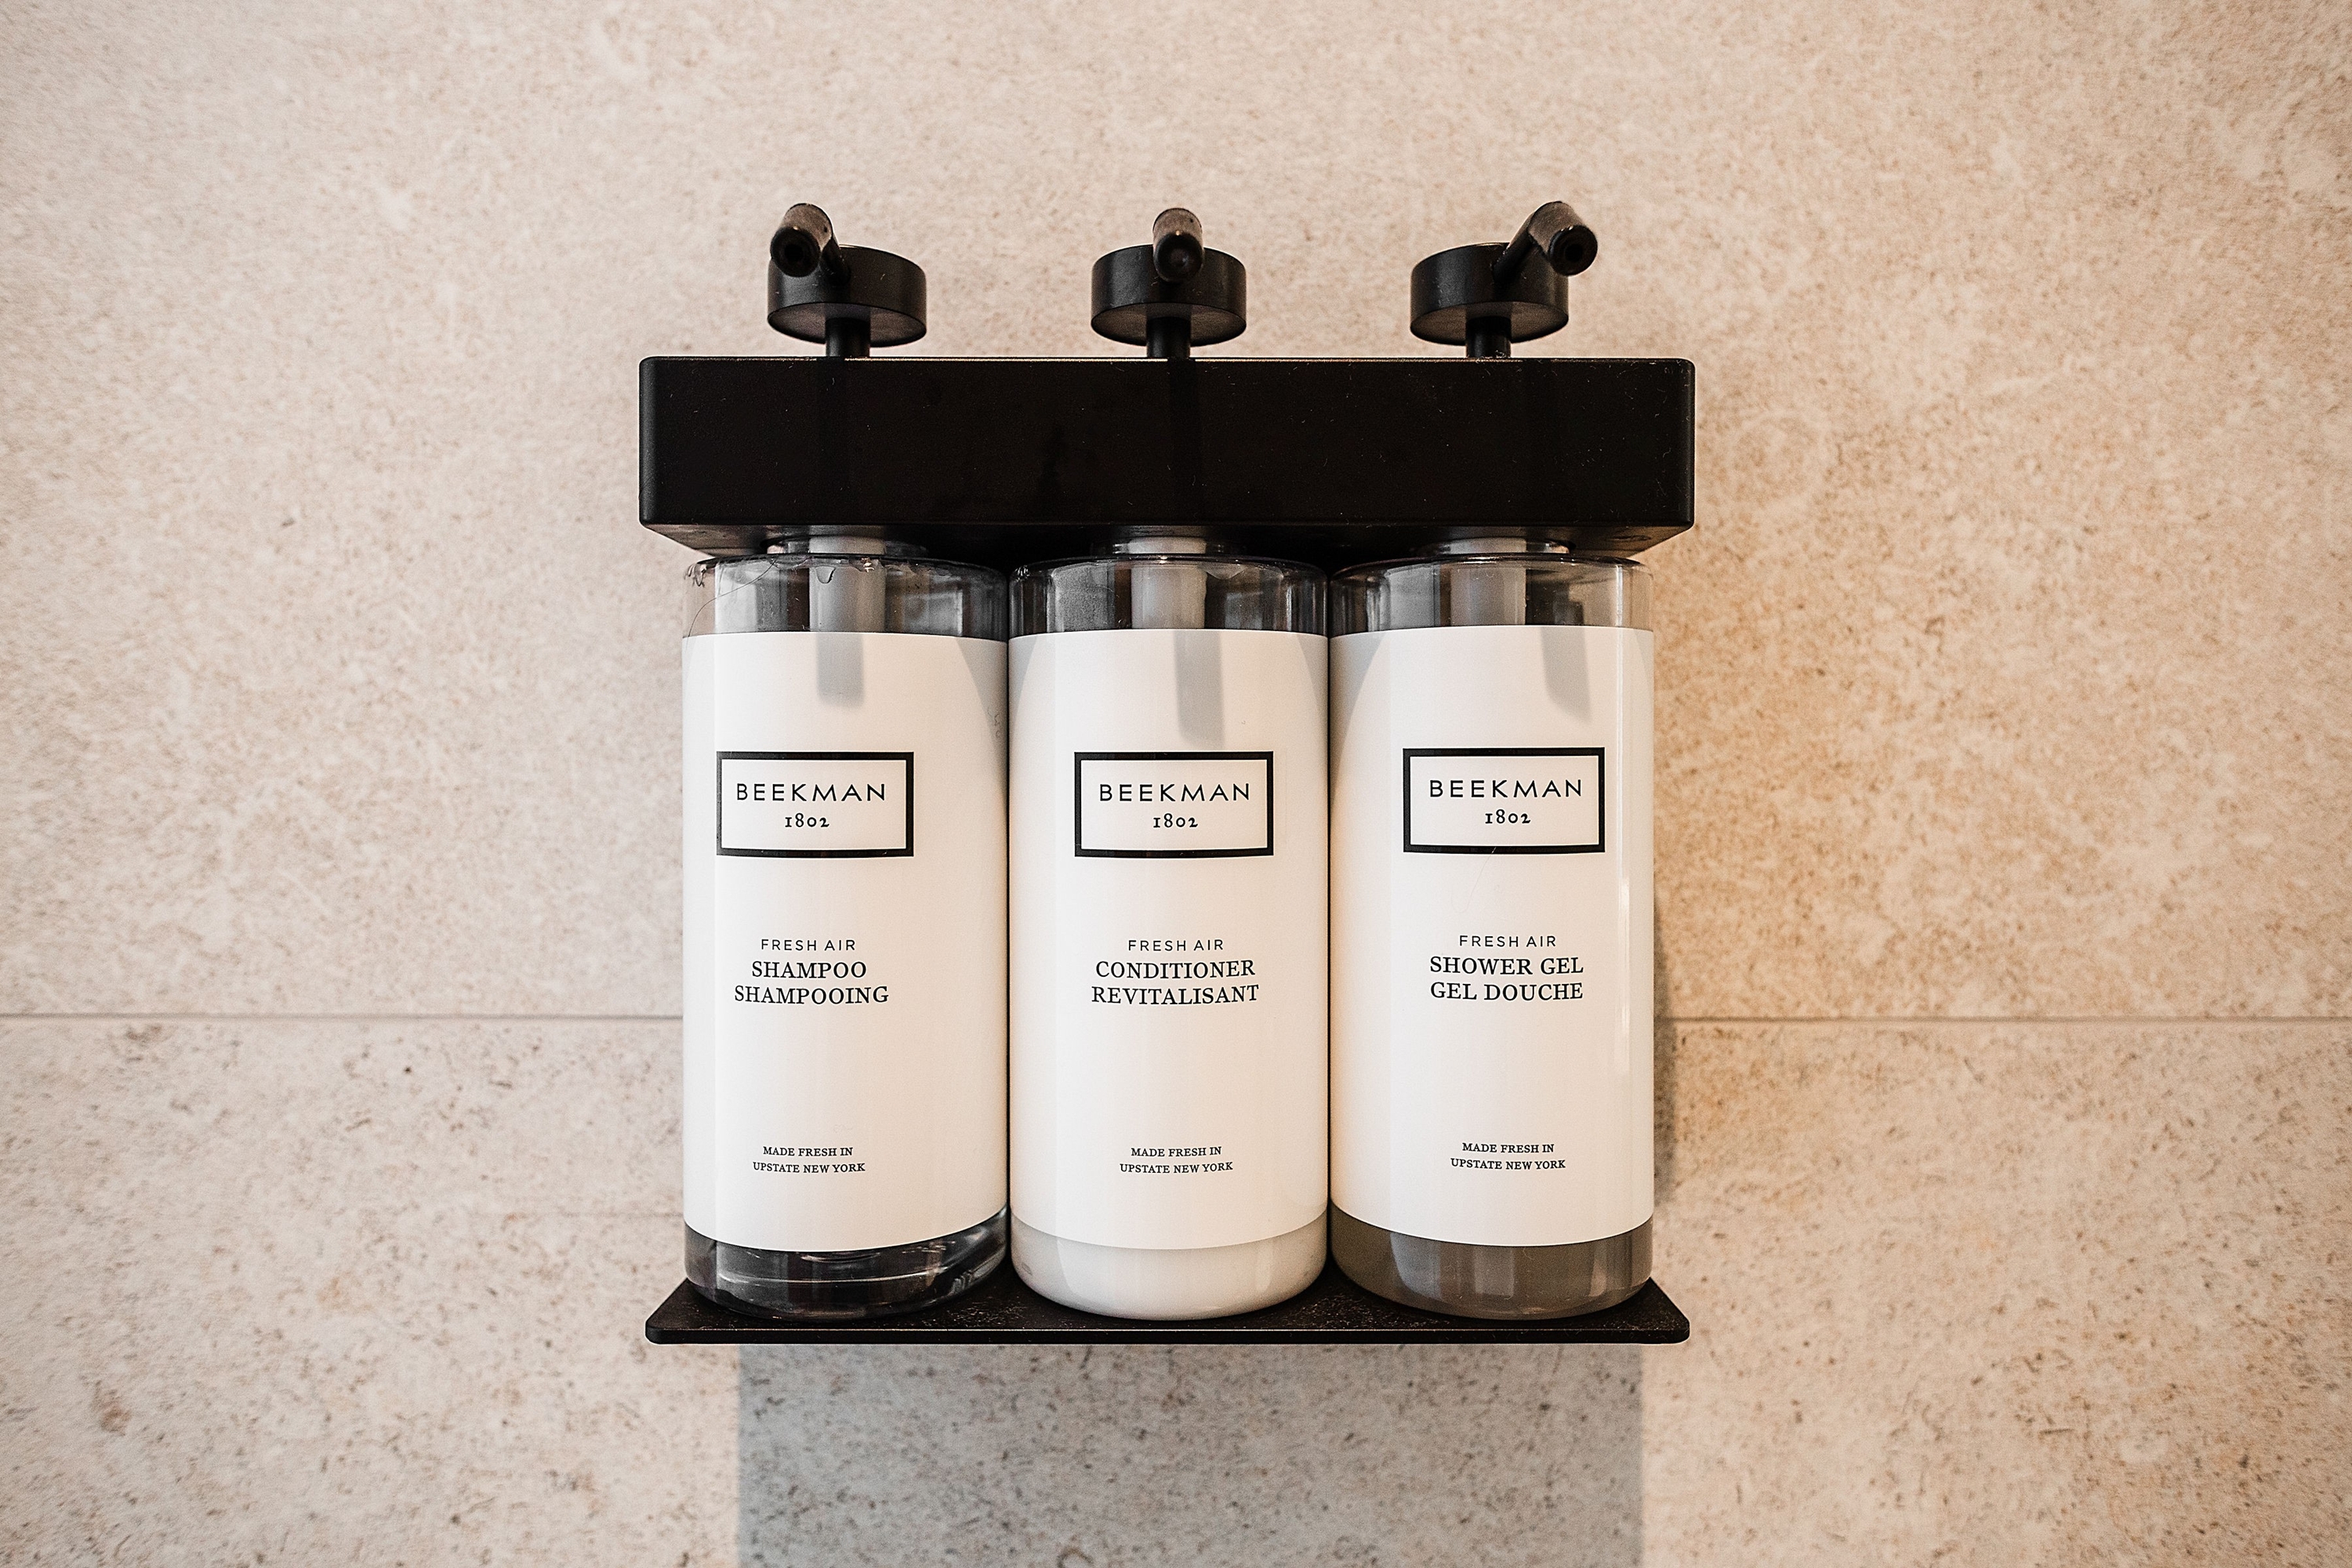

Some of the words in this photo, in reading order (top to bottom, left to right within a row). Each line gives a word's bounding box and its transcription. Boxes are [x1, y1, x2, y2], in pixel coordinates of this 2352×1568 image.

[736, 782, 885, 802] BEEKMAN
[1099, 782, 1250, 802] BEEKMAN
[1429, 779, 1582, 798] BEEKMAN
[784, 812, 830, 828] 1802
[1152, 812, 1199, 829] 1802
[1484, 808, 1531, 825] 1802
[760, 938, 817, 952] FRESH
[823, 939, 855, 952] AIR
[1128, 939, 1186, 952] FRESH
[1192, 938, 1224, 952] AIR
[1459, 935, 1519, 948] FRESH
[1526, 935, 1556, 948] AIR
[751, 960, 867, 979] SHAMPOO
[1095, 959, 1256, 979] CONDITIONER
[1429, 956, 1534, 975] SHOWER
[1540, 956, 1584, 975] GEL
[734, 985, 890, 1005] SHAMPOOING
[1091, 983, 1260, 1005] REVITALISANT
[1430, 981, 1478, 1000] GEL
[1483, 982, 1584, 1002] DOUCHE
[762, 1145, 796, 1157] MADE
[797, 1147, 838, 1157] FRESH
[839, 1146, 854, 1156] IN
[1131, 1147, 1166, 1157] MADE
[1167, 1147, 1207, 1157] FRESH
[1209, 1145, 1222, 1156] IN
[1461, 1142, 1498, 1153] MADE
[1500, 1144, 1540, 1154] FRESH
[1541, 1143, 1555, 1153] IN
[752, 1161, 800, 1174] UPSTATE
[803, 1164, 831, 1174] NEW
[831, 1162, 866, 1174] YORK
[1119, 1163, 1171, 1174] UPSTATE
[1173, 1163, 1200, 1174] NEW
[1201, 1161, 1234, 1173] YORK
[1450, 1157, 1503, 1170] UPSTATE
[1504, 1160, 1534, 1171] NEW
[1534, 1159, 1566, 1171] YORK
